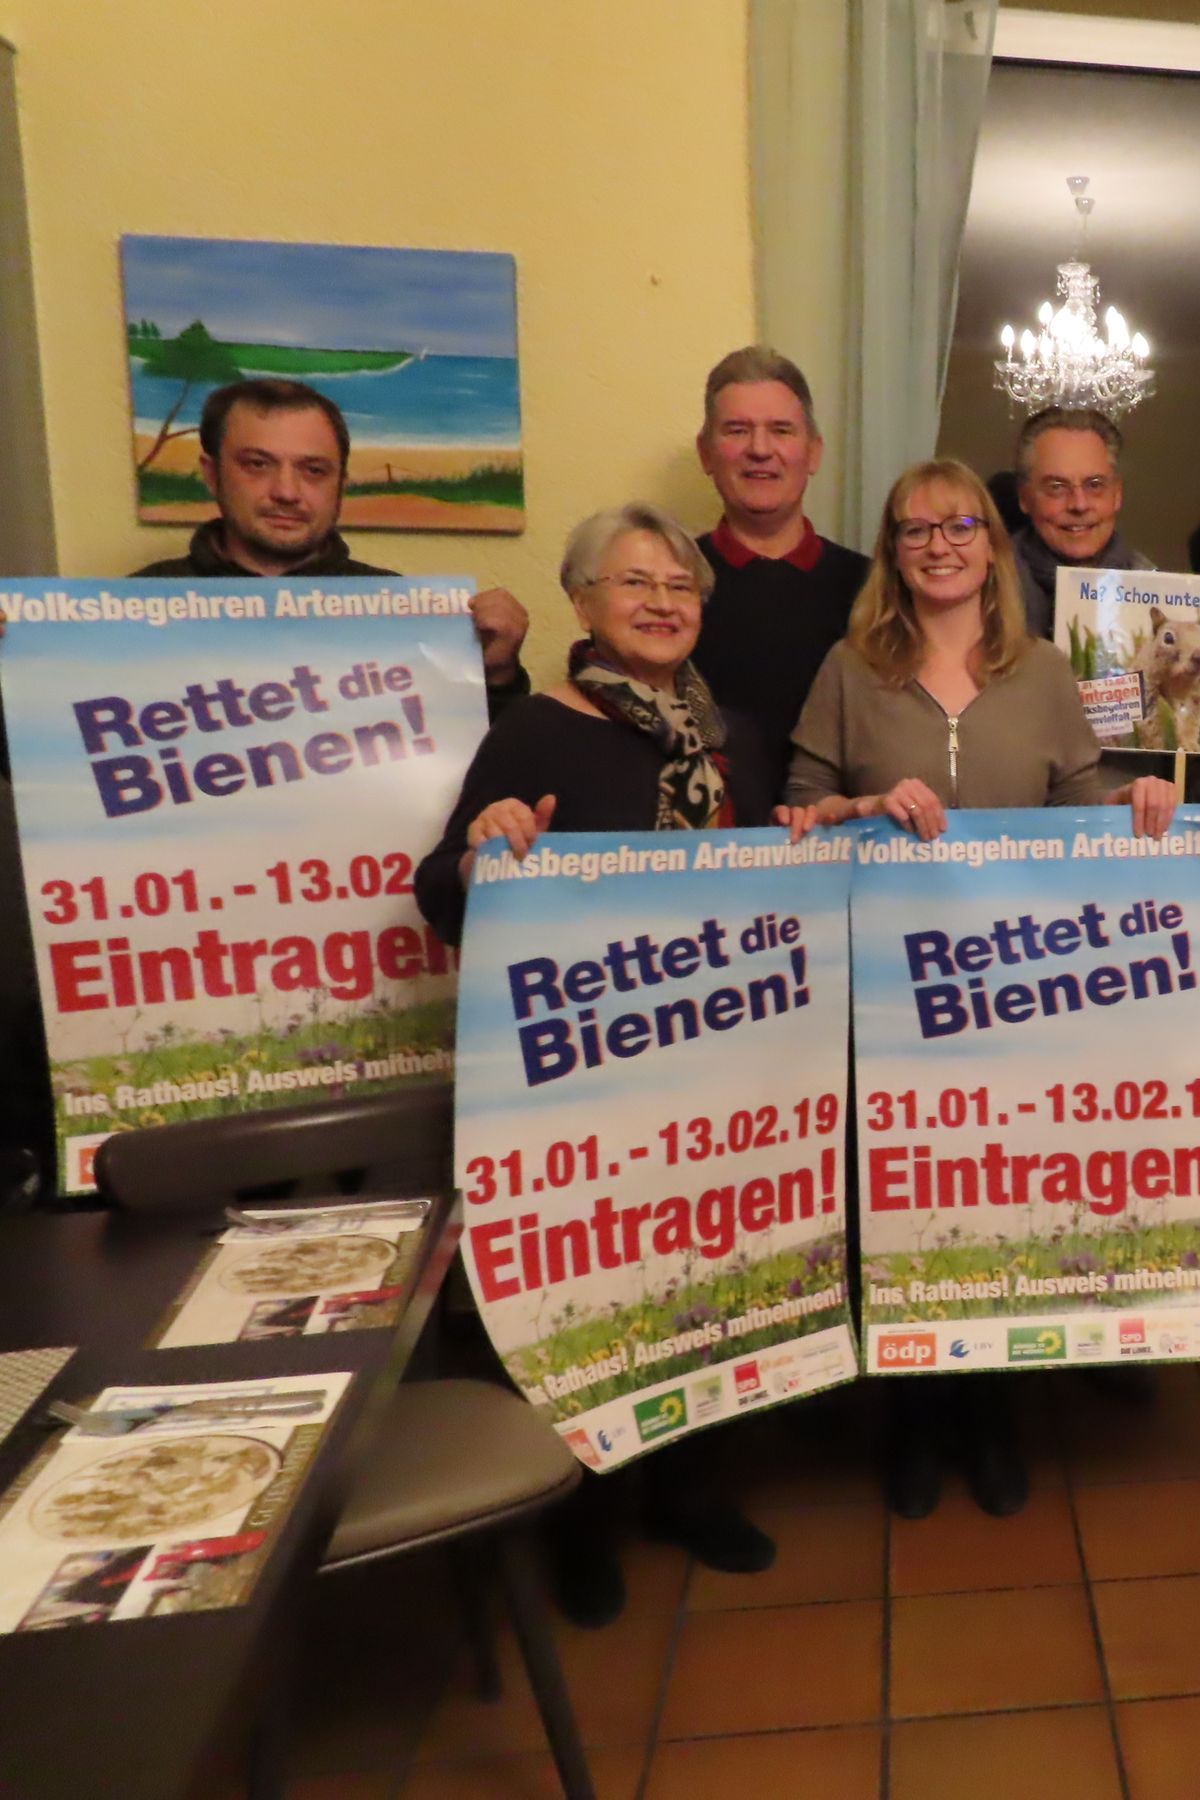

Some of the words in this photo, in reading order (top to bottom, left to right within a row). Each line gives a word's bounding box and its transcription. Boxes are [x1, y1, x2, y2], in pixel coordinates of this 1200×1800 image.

[0, 590, 265, 627] Volksbegehren
[275, 587, 472, 619] Artenvielfalt
[1116, 586, 1159, 604] Schon
[73, 665, 329, 755] Rettet
[338, 661, 414, 701] die
[91, 695, 437, 819] Bienen!
[474, 845, 687, 884] Volksbegehren
[693, 836, 851, 872] Artenvielfalt
[857, 834, 1064, 867] Volksbegehren
[507, 918, 731, 1021] Rettet
[740, 913, 802, 955] die
[904, 903, 1110, 982] Rettet
[1119, 900, 1184, 938] die
[519, 944, 811, 1088] Bienen!
[914, 931, 1198, 1039] Bienen!
[65, 1092, 111, 1117] Ins
[118, 1078, 238, 1111] Rathaus!
[248, 1065, 358, 1094] Ausweis
[470, 1147, 837, 1304] Eintragen!
[870, 1284, 904, 1305] Ins
[910, 1275, 1009, 1302] Rathaus!
[1015, 1271, 1108, 1297] Ausweis
[544, 1346, 629, 1400] Rathaus!
[634, 1311, 723, 1368] Ausweis
[728, 1282, 842, 1338] mitnehmen!
[882, 1341, 932, 1364] ödp
